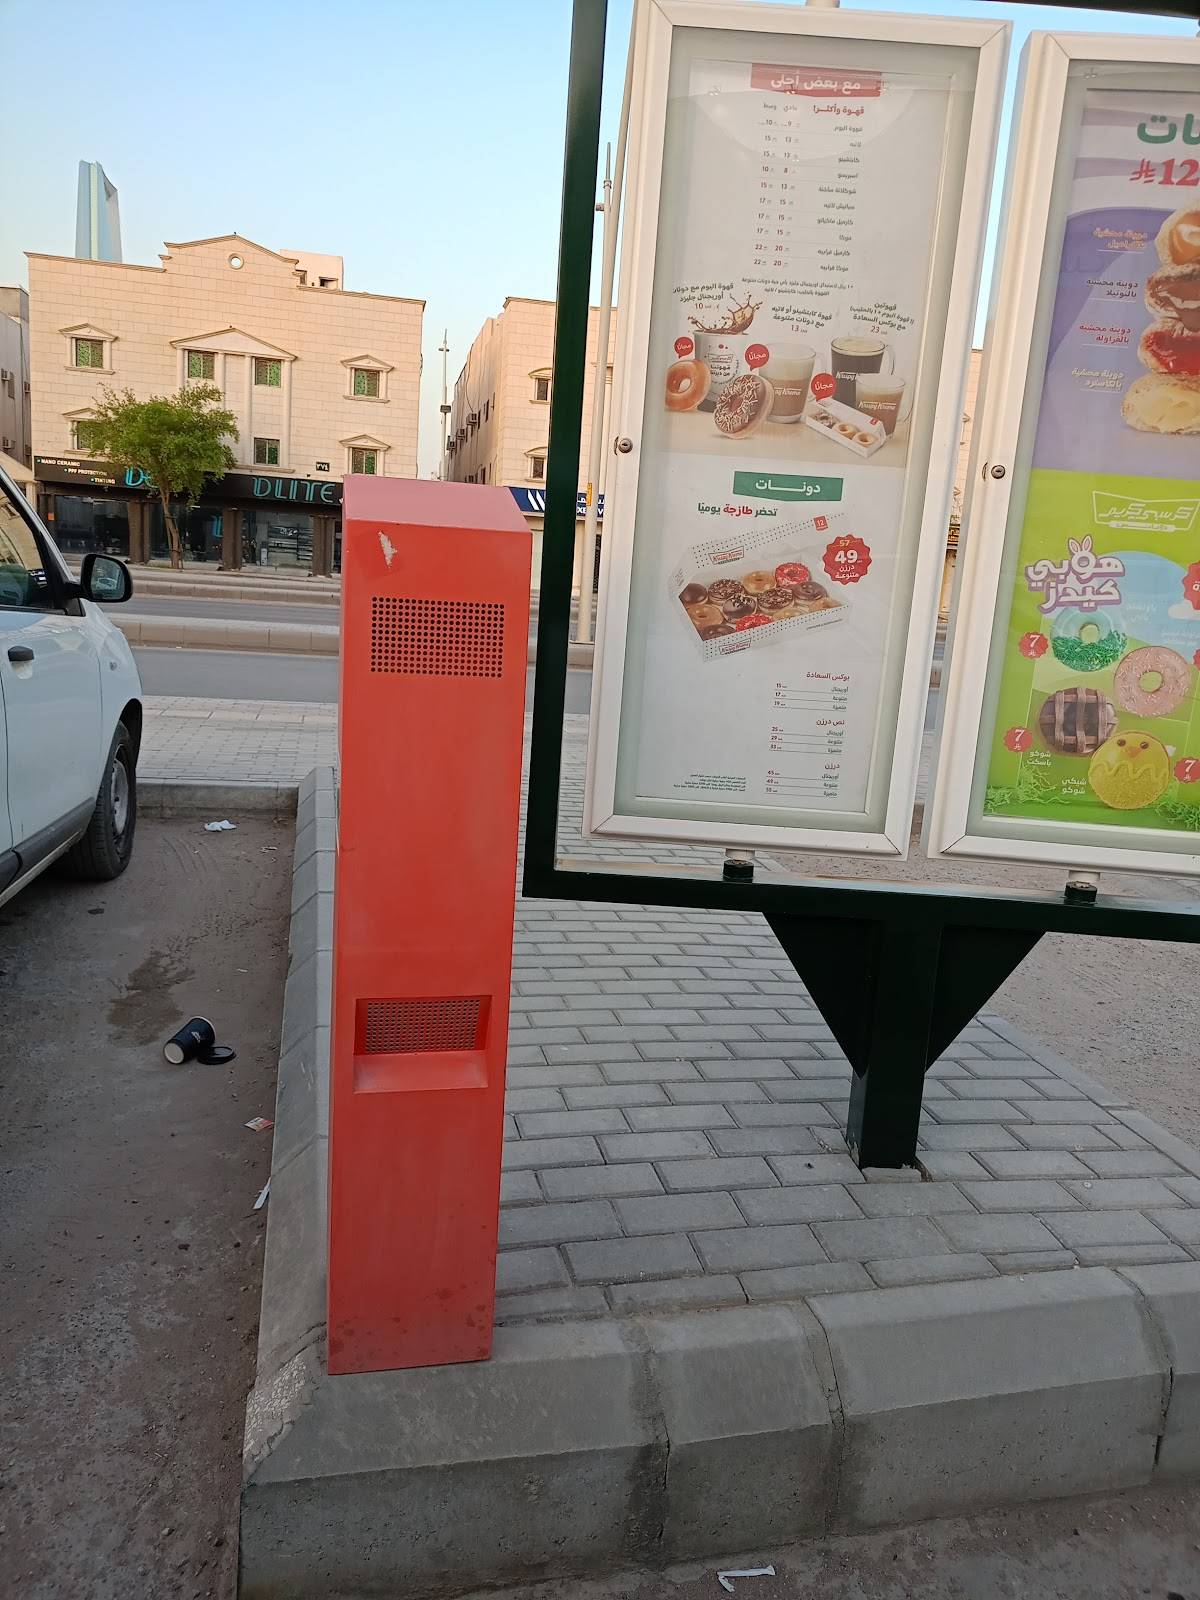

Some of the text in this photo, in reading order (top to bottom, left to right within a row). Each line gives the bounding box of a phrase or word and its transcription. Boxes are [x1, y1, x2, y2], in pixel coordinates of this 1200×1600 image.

[771, 70, 861, 94] مع بعض أحلى
[695, 302, 704, 310] 10
[56, 460, 81, 468] CERAMIC
[252, 477, 336, 504] DLITE
[755, 479, 821, 496] دونات
[723, 503, 753, 517] طازجة
[755, 506, 778, 518] تحضر
[816, 519, 825, 527] 12
[840, 539, 850, 547] 57
[835, 549, 858, 564] 49
[1029, 635, 1040, 648] 7
[806, 671, 850, 682] بوكس السعادة
[1015, 729, 1025, 741] 7
[1185, 759, 1197, 773] 7
